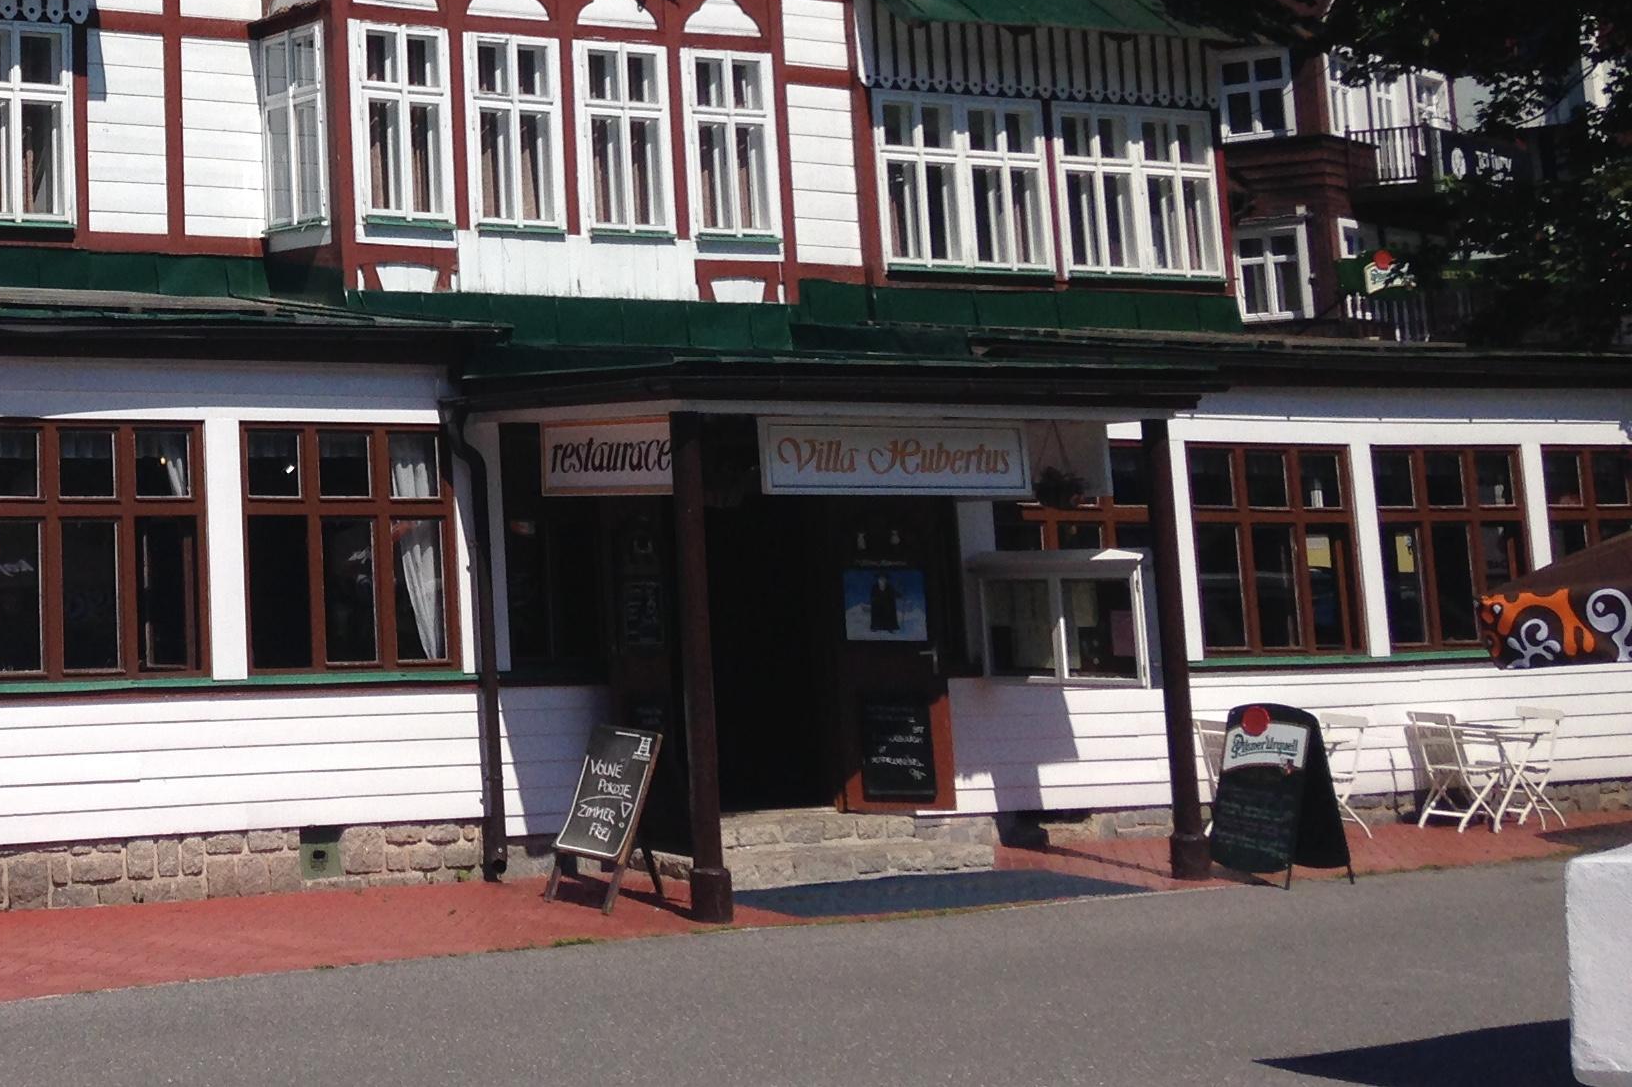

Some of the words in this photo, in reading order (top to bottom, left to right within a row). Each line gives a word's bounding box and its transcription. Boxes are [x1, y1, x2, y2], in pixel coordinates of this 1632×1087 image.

[550, 436, 672, 474] restaurace
[777, 437, 859, 475] Villa
[868, 438, 1011, 476] Hubertus
[1230, 733, 1265, 759] Pilsner
